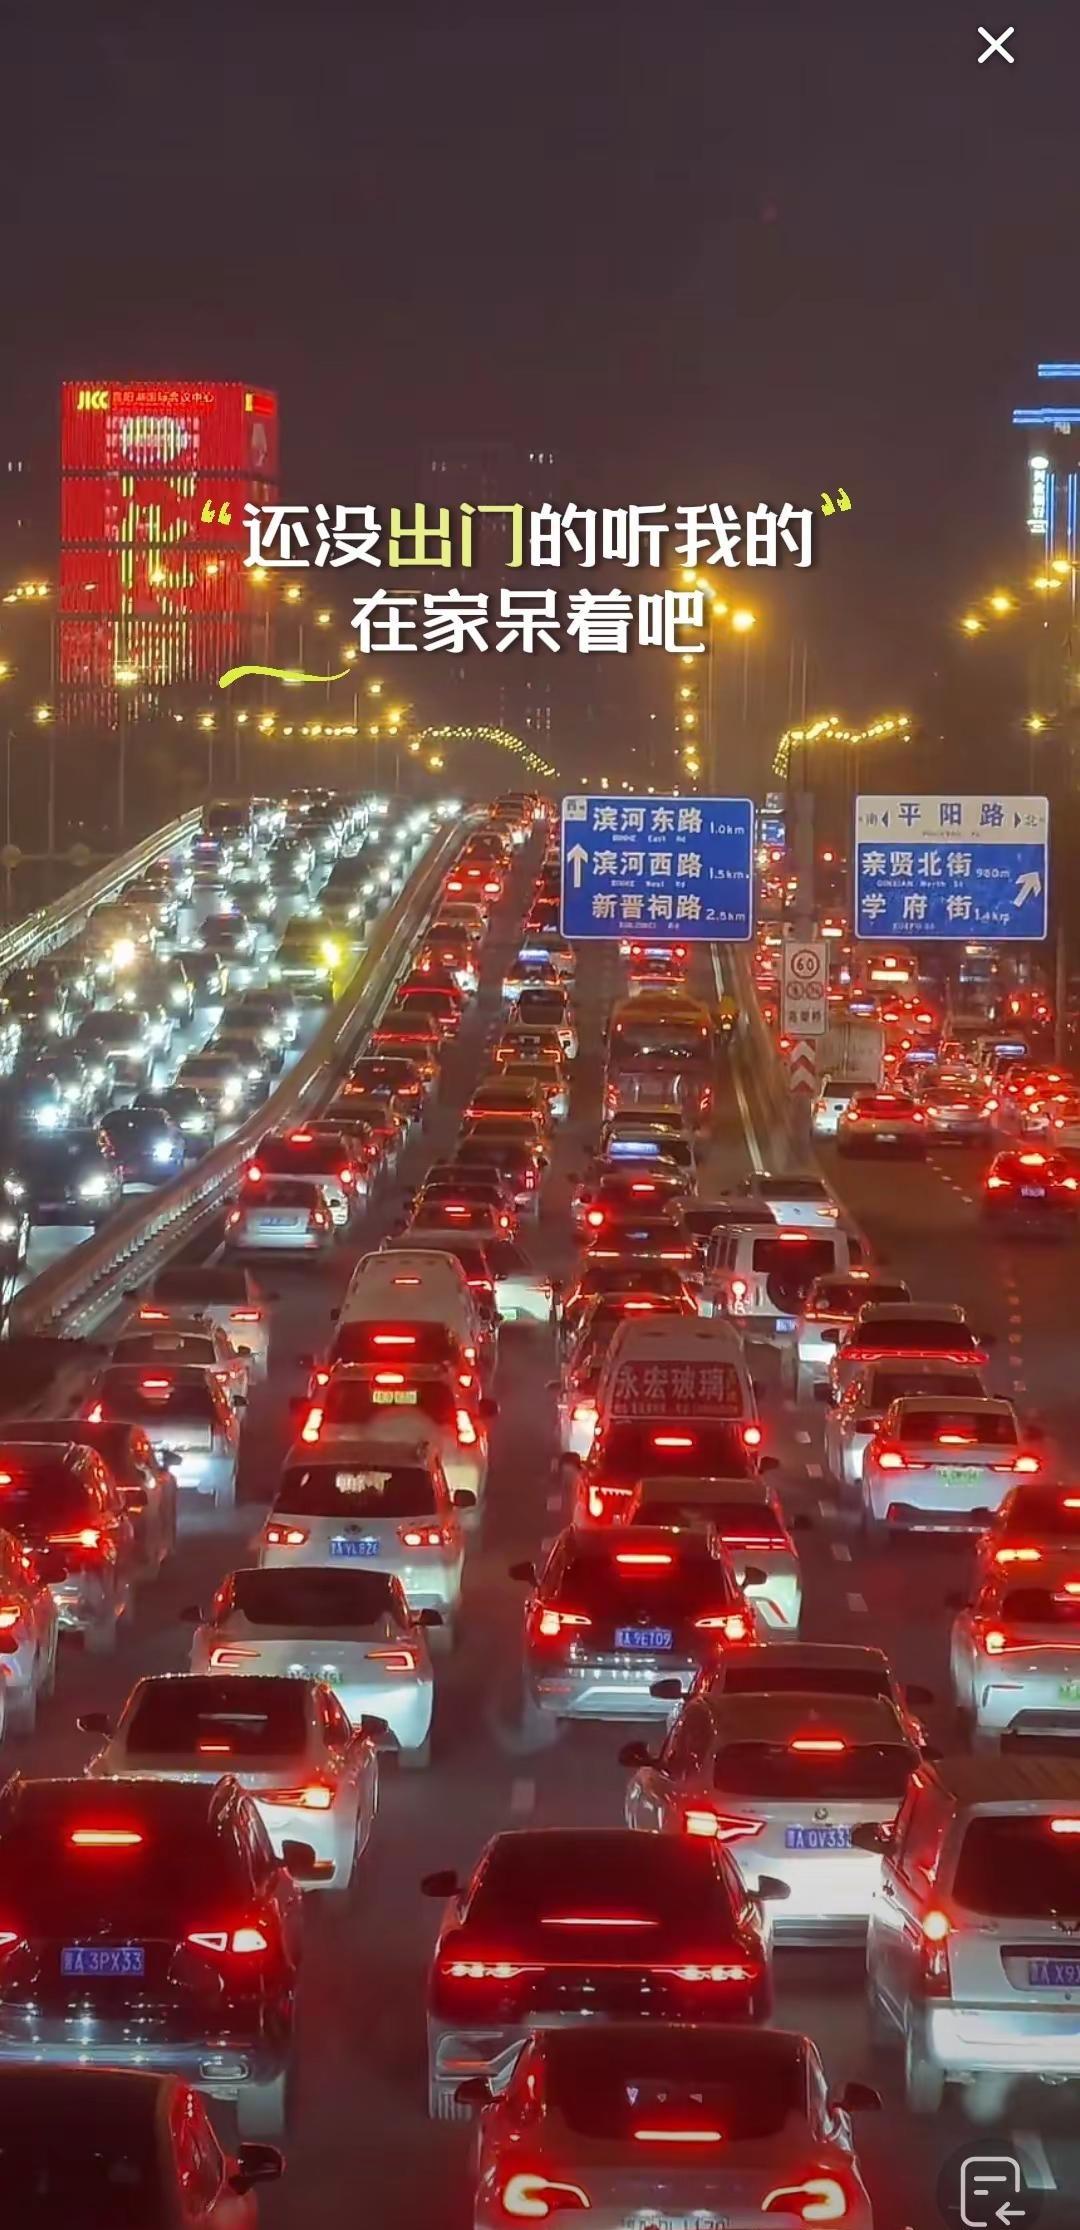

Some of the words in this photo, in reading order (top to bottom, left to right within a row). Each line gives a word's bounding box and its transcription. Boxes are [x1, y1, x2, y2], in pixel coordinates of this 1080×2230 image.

[77, 390, 110, 410] JICC
[592, 806, 703, 834] 滨河东路
[710, 821, 745, 835] 1.0km
[898, 803, 1004, 827] 平阳路
[592, 850, 703, 879] 滨河西路
[709, 867, 744, 879] 1.5km
[862, 850, 972, 877] 亲贤北街
[976, 868, 1010, 878] 980m
[592, 892, 702, 920] 新晋祠路
[706, 908, 745, 921] 2.5km
[862, 893, 972, 920] 学府街
[797, 958, 814, 971] 60
[613, 1365, 725, 1402] 永宏玻璃
